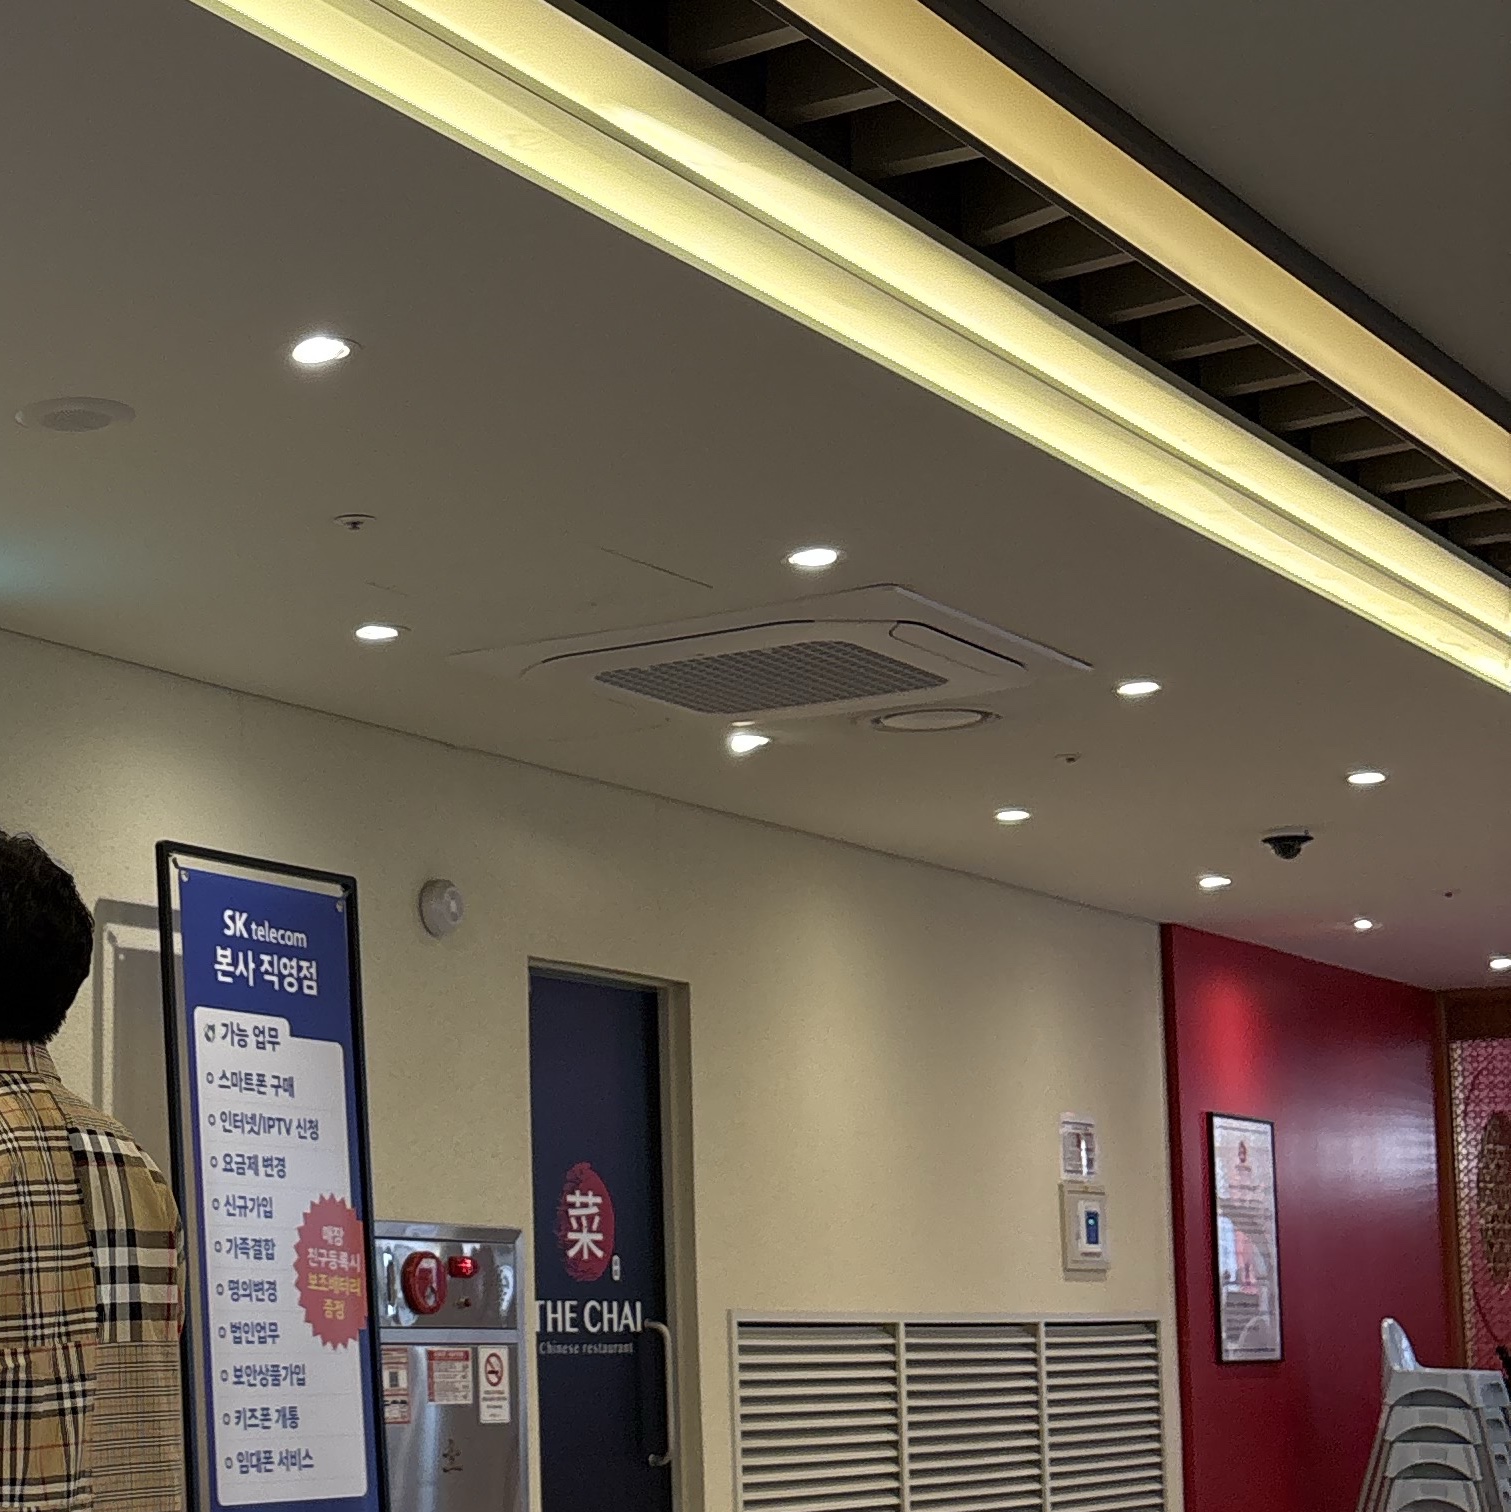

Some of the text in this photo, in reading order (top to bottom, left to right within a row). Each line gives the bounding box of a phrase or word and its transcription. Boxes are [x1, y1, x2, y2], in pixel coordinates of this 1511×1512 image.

[223, 909, 308, 948] SK telecom
[214, 945, 318, 996] 본사 직영점
[220, 1021, 281, 1052] 가능 업무
[218, 1069, 295, 1098] 스마트폰 구매
[219, 1110, 319, 1141] 인터넷/IPTV 신청
[222, 1152, 287, 1179] 요금제 변경
[224, 1194, 274, 1219] 신규가입
[566, 1189, 604, 1260] 菜
[225, 1236, 276, 1261] 가족결합
[228, 1279, 278, 1303] 명의변경
[323, 1298, 346, 1320] 증정
[535, 1300, 642, 1333] THE CHAI
[230, 1321, 280, 1345] 법인업무
[539, 1341, 580, 1355] Chinese
[232, 1363, 306, 1388] 보안상품가입
[234, 1405, 300, 1430] 키즈폰 개통
[236, 1448, 315, 1475] 임대폰 서비스
